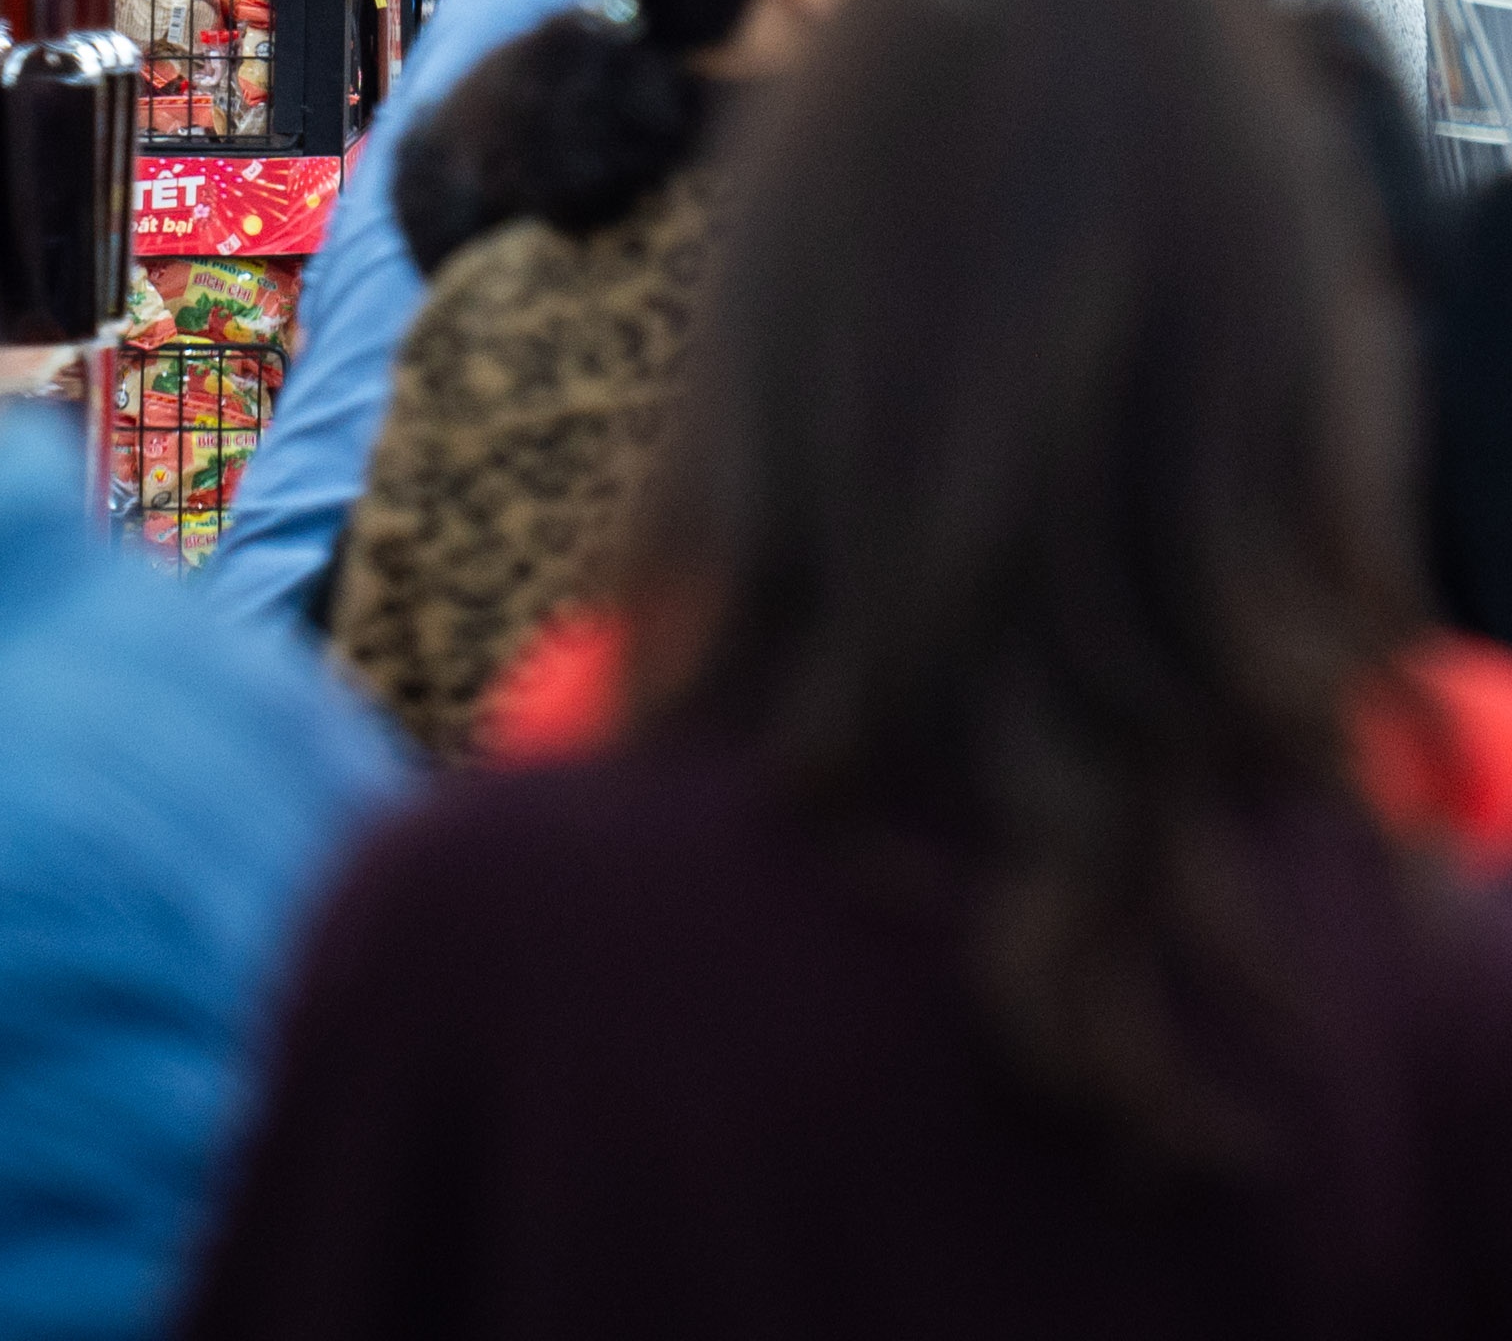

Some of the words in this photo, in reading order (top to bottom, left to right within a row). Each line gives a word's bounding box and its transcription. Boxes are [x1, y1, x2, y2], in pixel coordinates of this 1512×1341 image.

[133, 163, 206, 211] TẾT
[162, 216, 194, 237] bại
[193, 271, 226, 294] BÍCH
[228, 281, 253, 303] CHI
